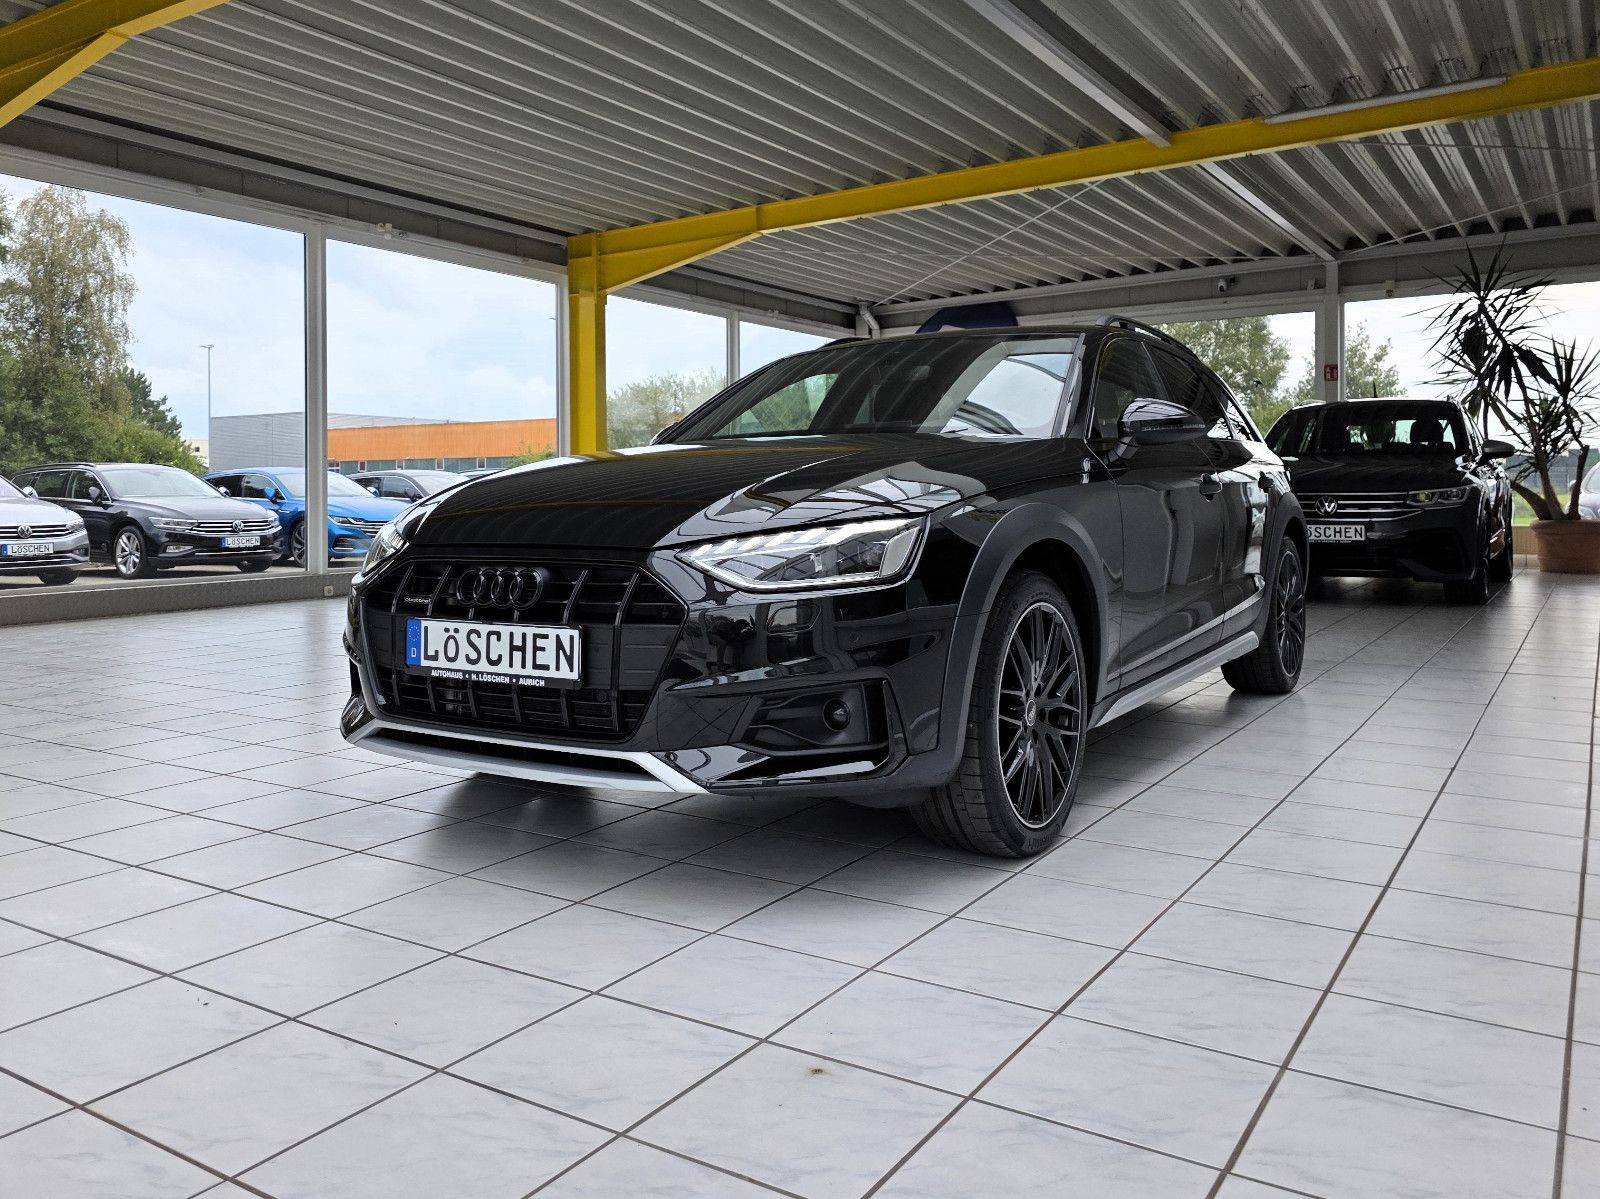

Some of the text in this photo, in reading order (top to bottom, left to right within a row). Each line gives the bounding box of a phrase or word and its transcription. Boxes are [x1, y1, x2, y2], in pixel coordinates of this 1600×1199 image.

[1307, 526, 1363, 539] ÖSCHEN
[411, 647, 417, 658] D
[423, 625, 574, 673] LÖSCHEN
[431, 669, 463, 680] AUTOHAUS
[518, 677, 545, 686] AURICH
